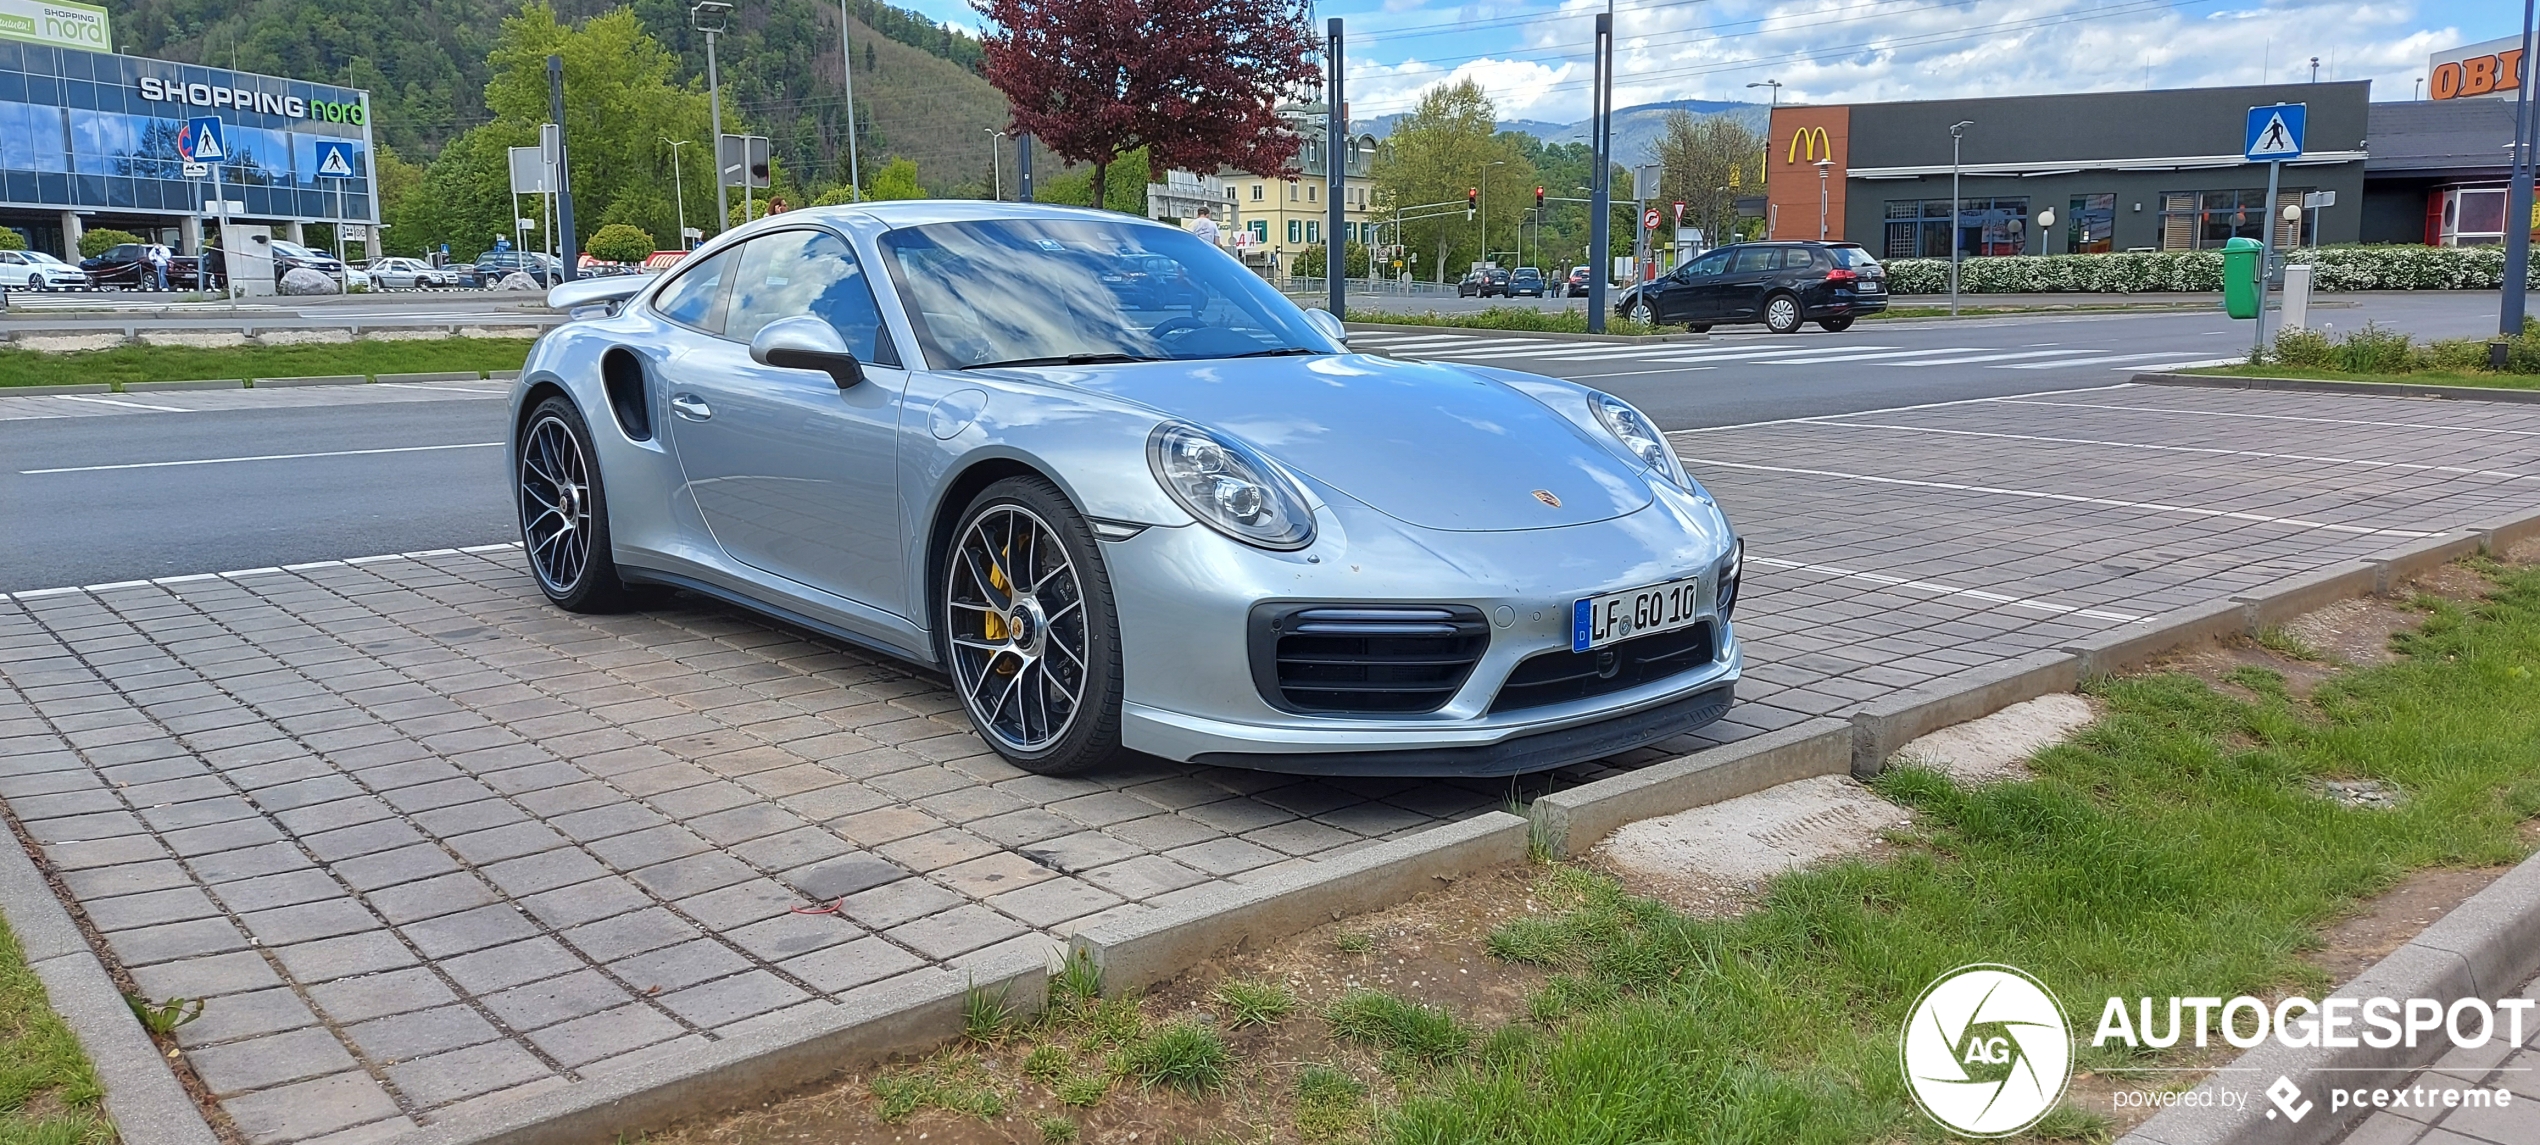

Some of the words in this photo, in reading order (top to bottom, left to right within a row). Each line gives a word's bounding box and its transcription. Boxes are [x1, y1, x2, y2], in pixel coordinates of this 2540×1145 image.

[44, 8, 95, 23] SHOPPING
[45, 17, 103, 43] nord
[2431, 48, 2523, 100] OBI
[140, 76, 304, 118] SHOPPING
[310, 97, 365, 126] nord
[1592, 600, 1620, 641] LF
[1634, 591, 1663, 630] GO
[1669, 584, 1695, 623] 10
[1579, 630, 1586, 641] D
